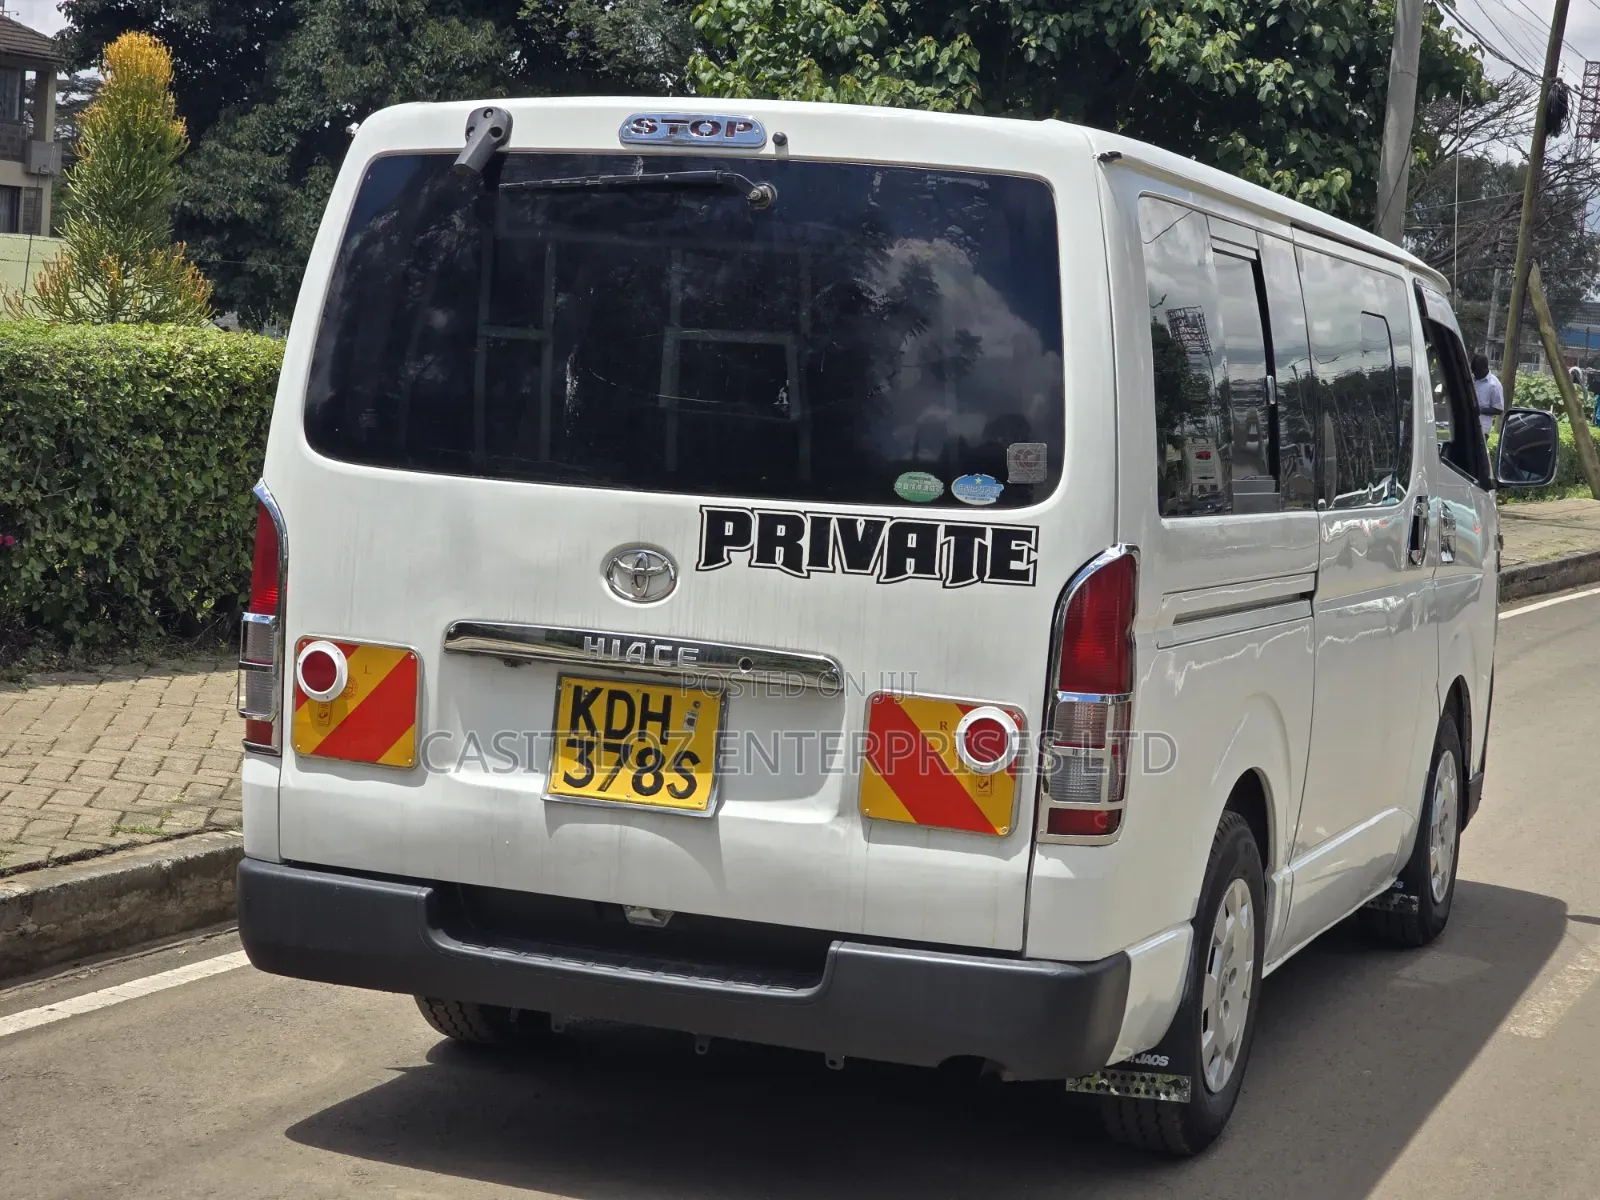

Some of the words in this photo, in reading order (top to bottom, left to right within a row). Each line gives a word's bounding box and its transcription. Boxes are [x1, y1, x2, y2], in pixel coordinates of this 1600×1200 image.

[630, 117, 754, 138] STOP
[695, 504, 1040, 589] PRIVATE
[583, 636, 699, 668] HIACE
[569, 685, 672, 745] KDH
[939, 720, 949, 731] R
[563, 739, 701, 799] 378S
